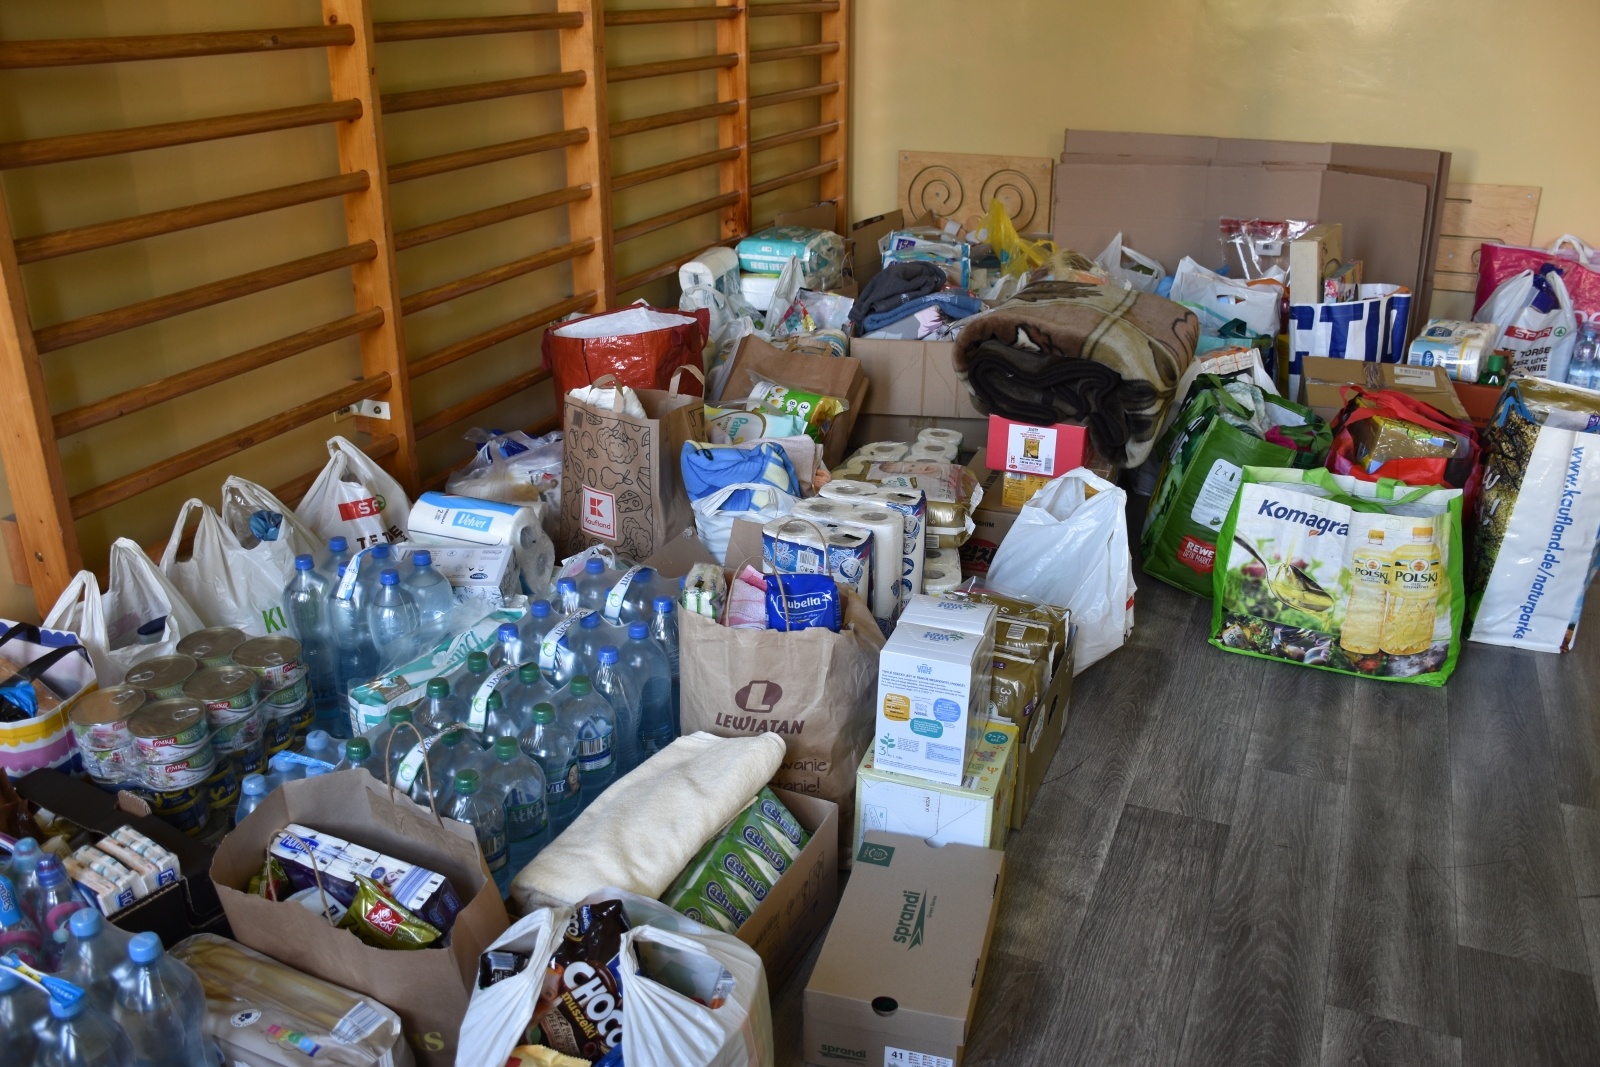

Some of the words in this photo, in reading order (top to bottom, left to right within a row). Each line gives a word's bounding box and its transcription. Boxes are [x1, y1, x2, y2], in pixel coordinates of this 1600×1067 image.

[1514, 328, 1552, 339] SPAR
[728, 417, 749, 441] Pam
[458, 512, 487, 529] Velvet
[585, 517, 611, 530] Kaufland
[1258, 499, 1349, 537] Komagra
[1187, 541, 1216, 558] REWE
[1512, 446, 1584, 639] www.kaufland.de/naturparke
[1195, 554, 1212, 565] MARKT
[1355, 567, 1389, 580] POLSKI
[1395, 571, 1438, 583] POLSKI
[715, 712, 805, 735] LEWIATAN
[780, 758, 828, 772] wanie
[546, 780, 565, 794] VIT
[776, 777, 821, 793] tanie!
[893, 890, 920, 943] sprandi
[561, 991, 598, 1040] muszelki
[821, 1043, 867, 1059] sprandi
[891, 1051, 904, 1060] 41
